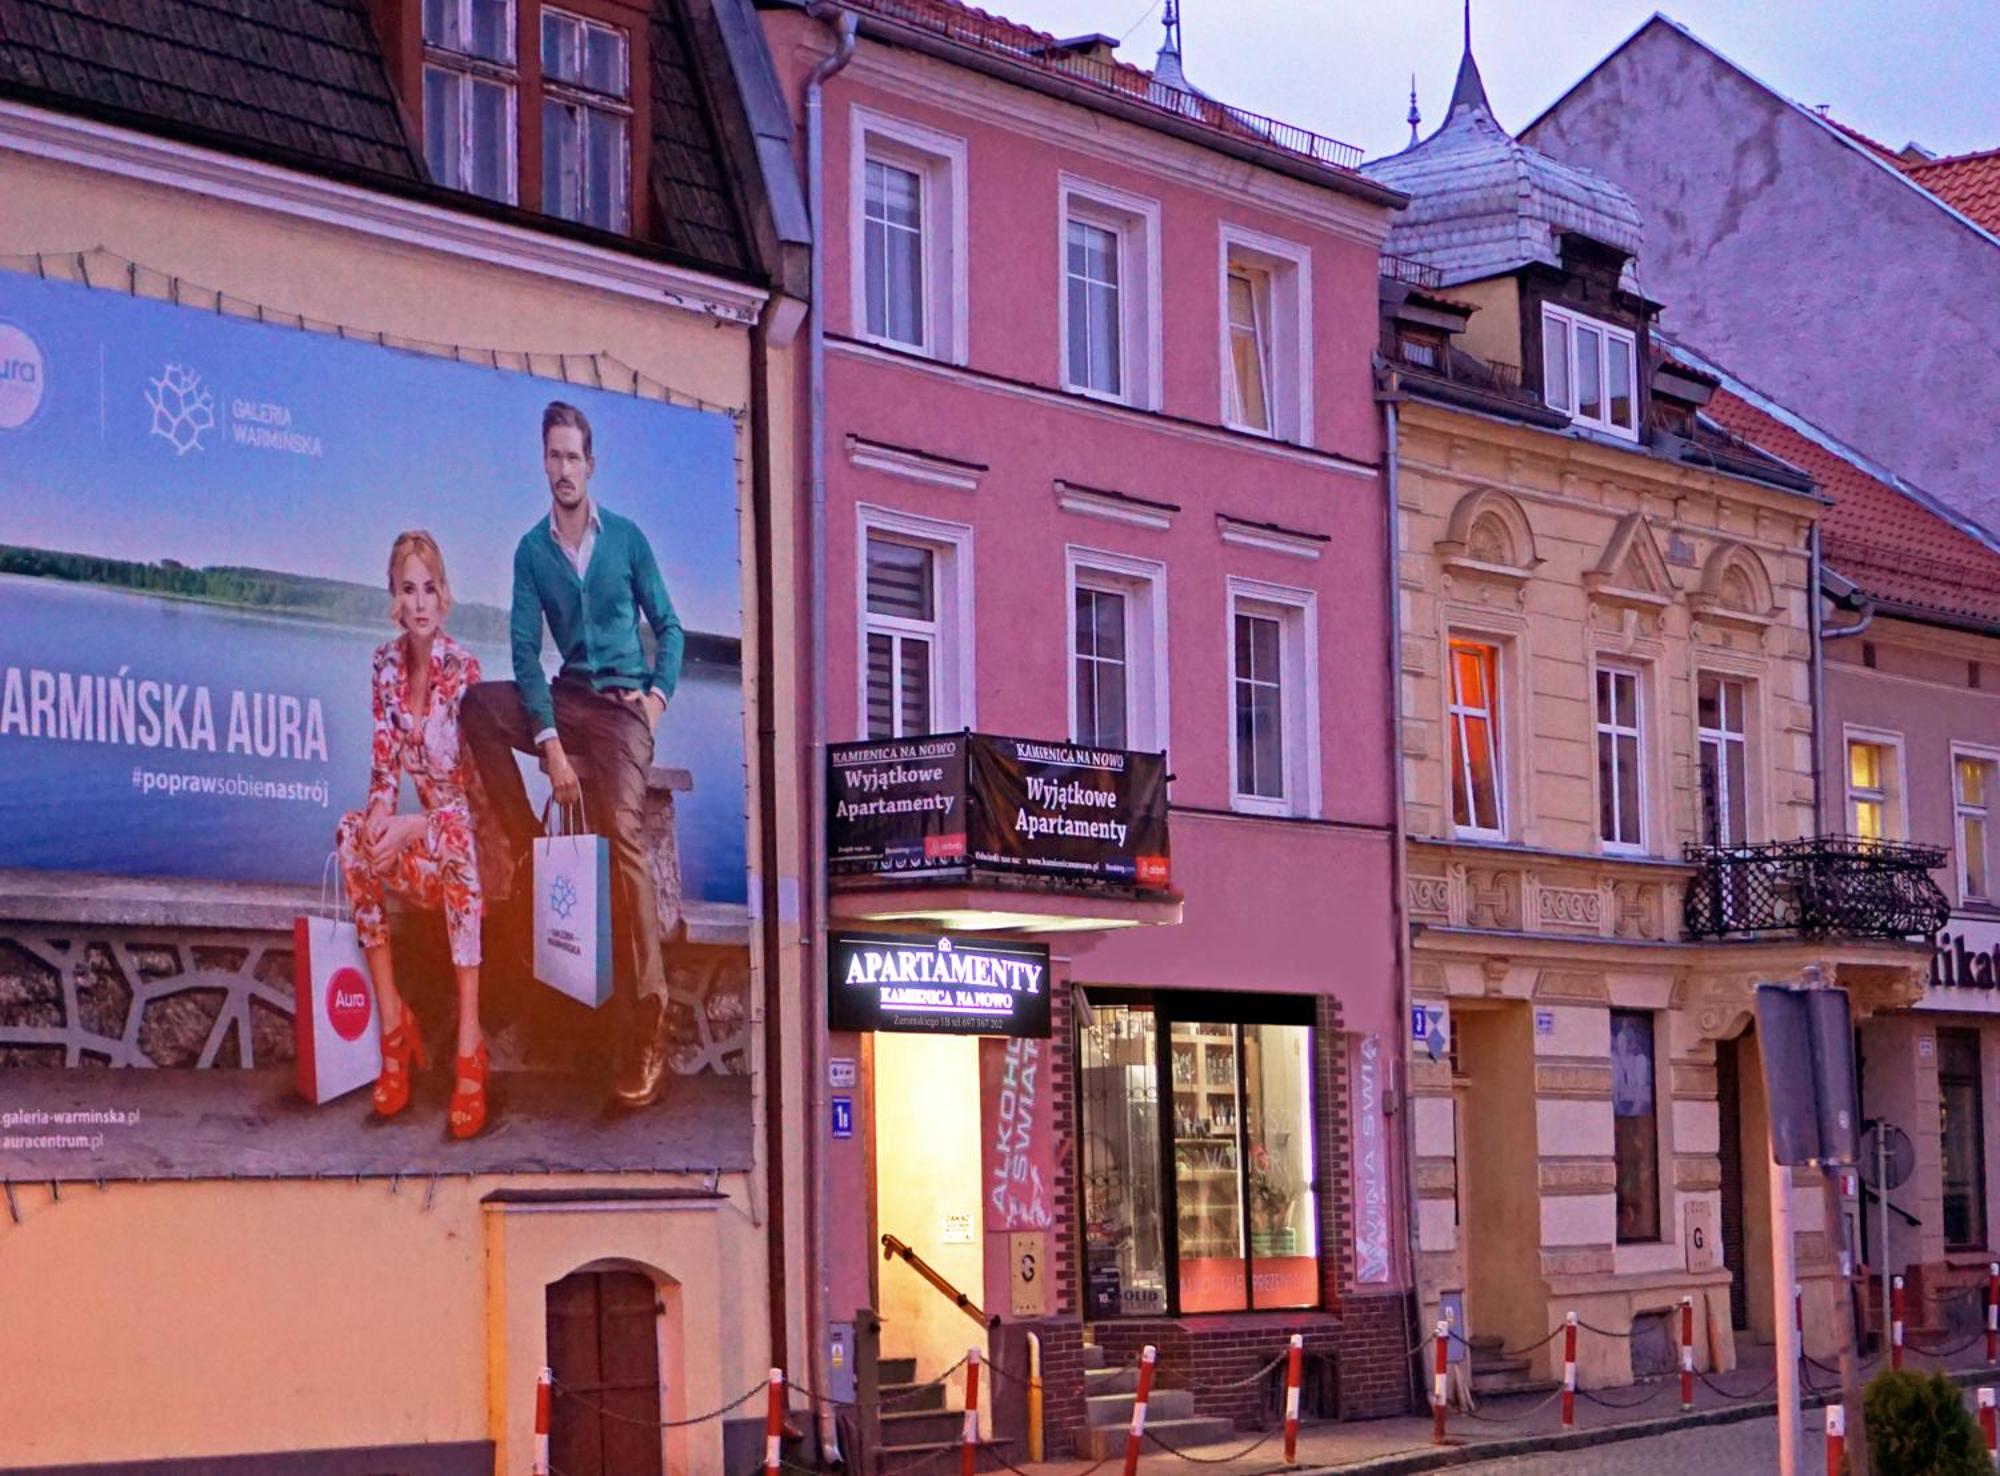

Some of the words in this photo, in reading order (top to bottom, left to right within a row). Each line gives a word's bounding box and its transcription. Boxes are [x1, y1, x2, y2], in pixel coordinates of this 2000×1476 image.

[232, 399, 292, 426] GALERIA
[1, 665, 216, 752] ARMIŃSKA
[227, 690, 328, 762] AURA
[832, 747, 898, 765] KAMIENICA
[900, 746, 917, 759] NA
[919, 742, 956, 757] NOWO
[1016, 743, 1075, 765] KAMIENICA
[1076, 750, 1092, 766] NA
[1093, 753, 1124, 769] NOWO
[132, 766, 328, 807] #poprawsobienastrój
[845, 767, 943, 791] Wyjątkowe
[1026, 776, 1117, 808] Wyjątkowe
[836, 793, 954, 821] Apartamenty
[1015, 808, 1127, 847] Apartamenty
[845, 950, 1043, 994] APARTAMENTY
[334, 989, 365, 1009] Aura
[880, 987, 954, 1006] KAMIENICA
[956, 991, 974, 1007] NA
[974, 992, 1013, 1009] NOWO
[1694, 1227, 1703, 1249] G
